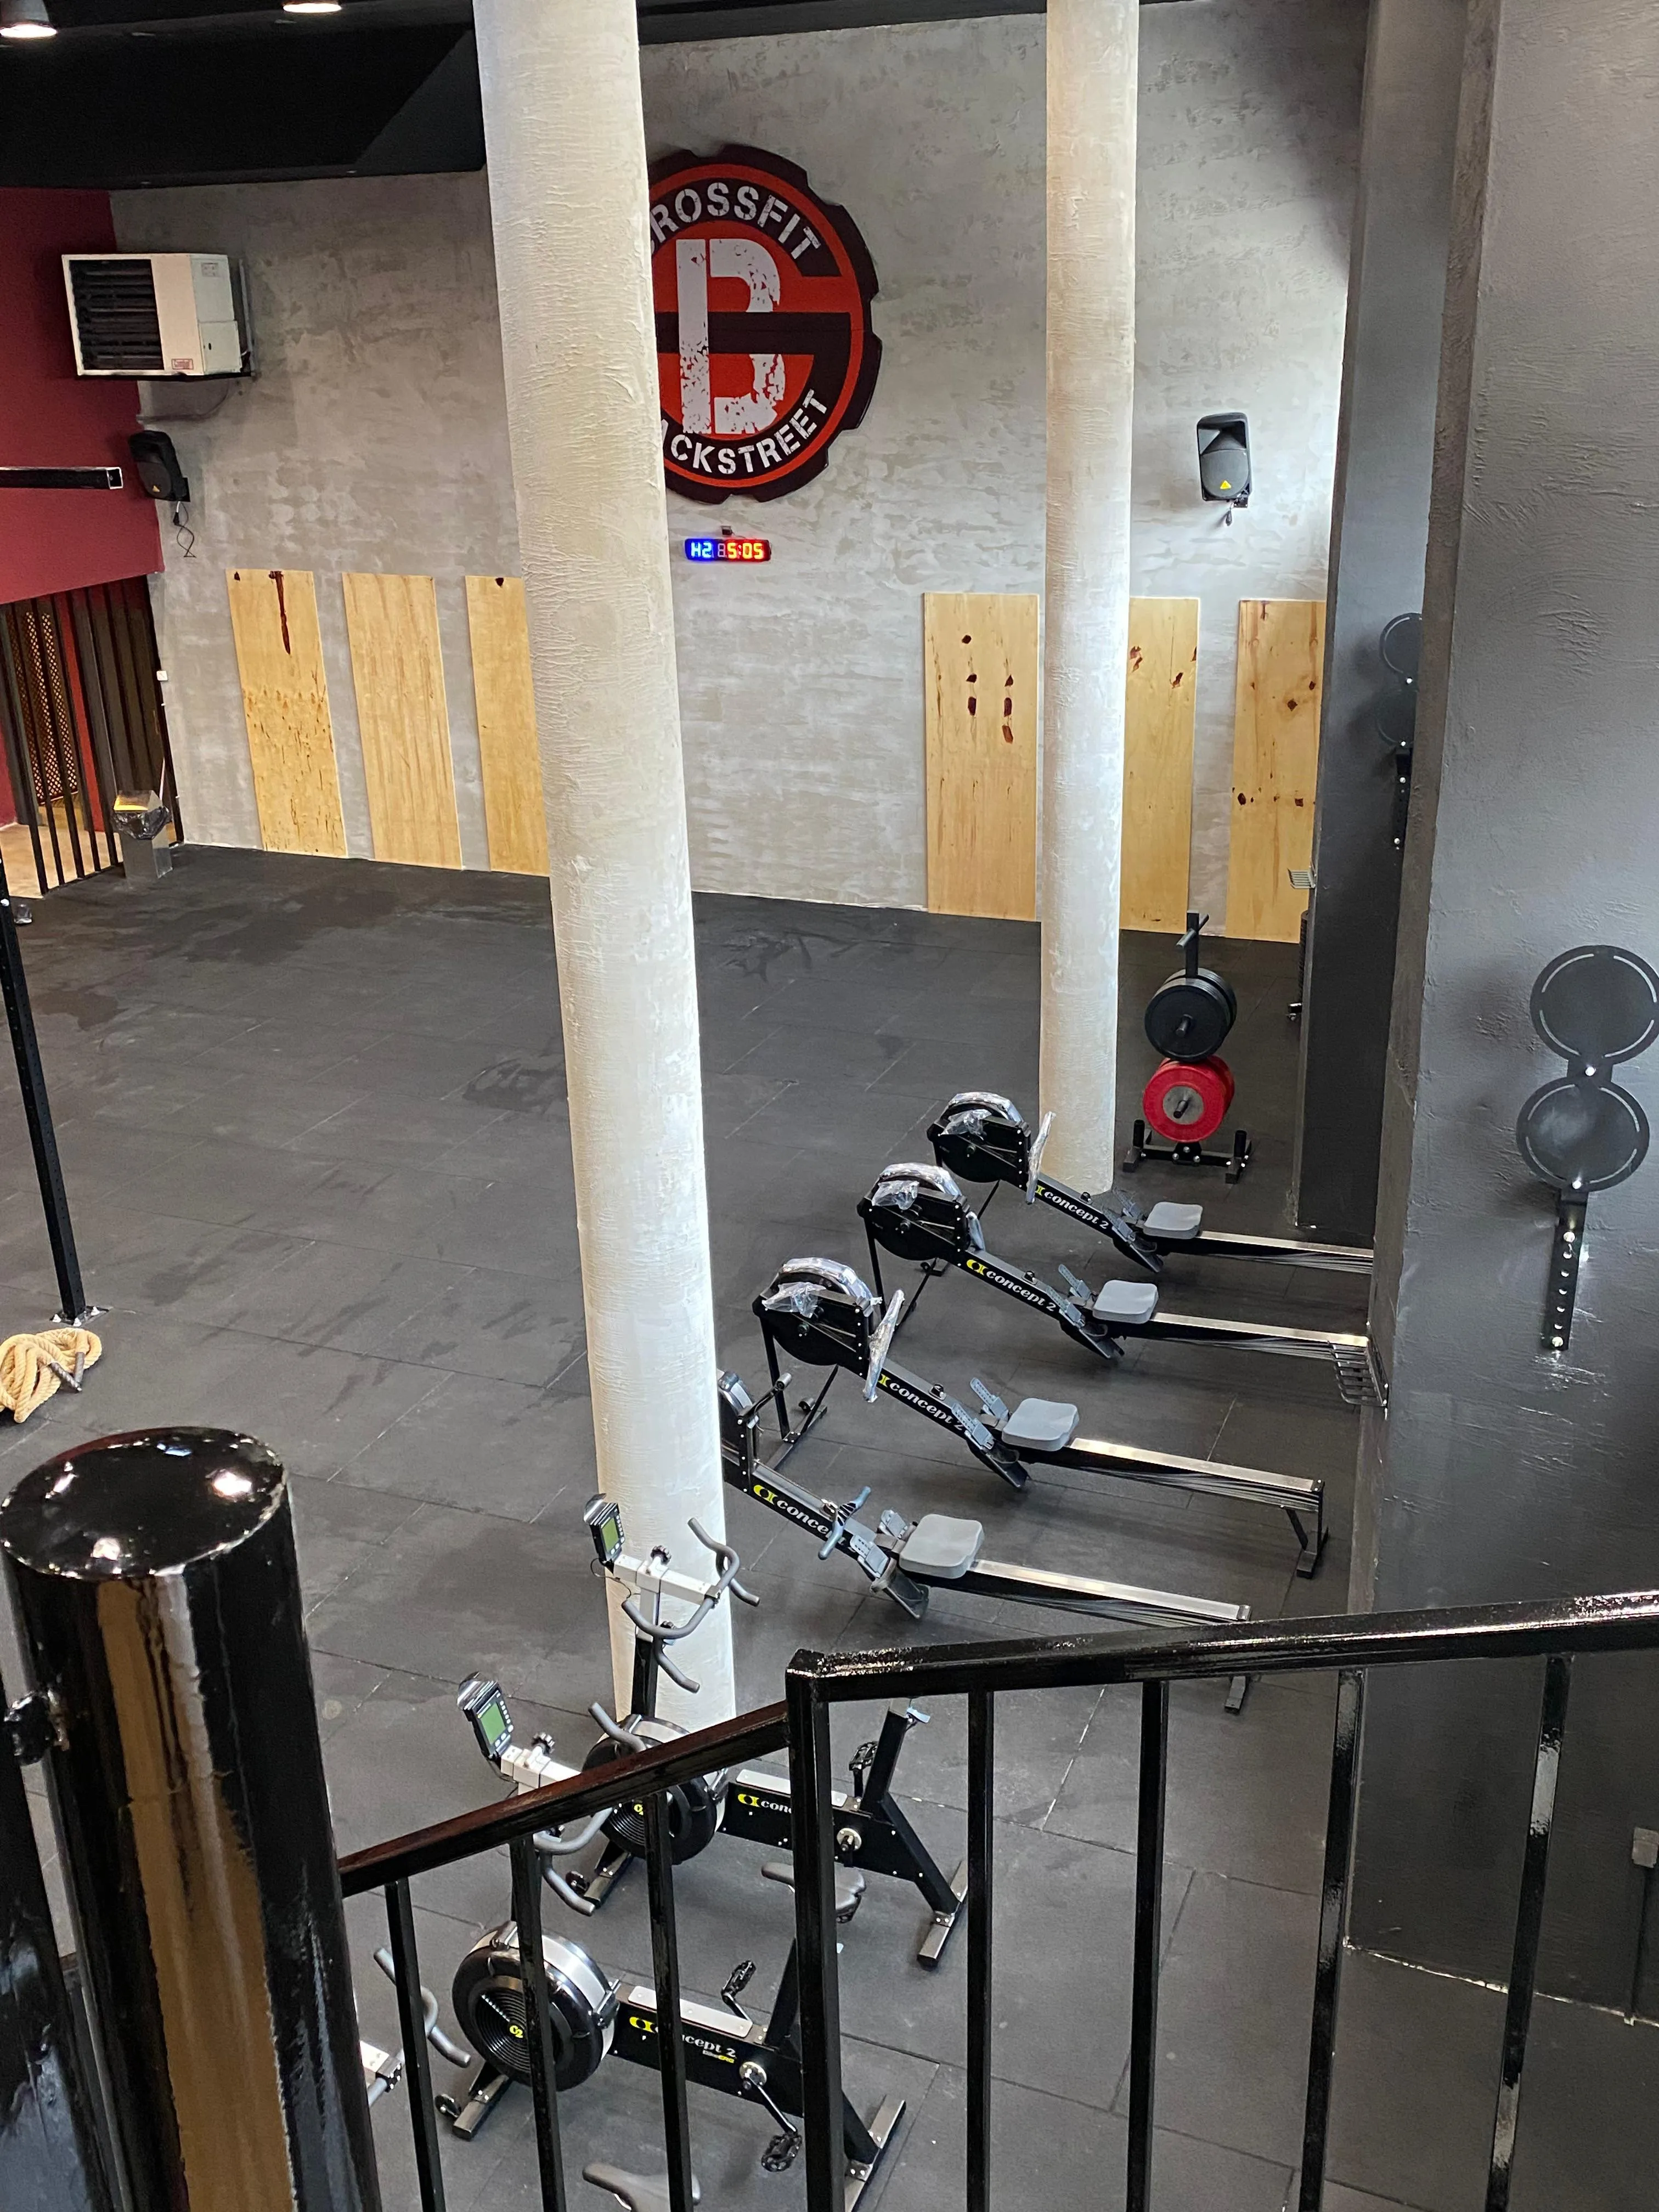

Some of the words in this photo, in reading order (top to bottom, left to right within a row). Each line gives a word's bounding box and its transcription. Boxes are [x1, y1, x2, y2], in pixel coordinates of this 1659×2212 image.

[650, 182, 821, 259] ROSSFIT
[661, 388, 827, 475] CKSTREET
[1044, 1192, 1099, 1224] concept
[1099, 1220, 1109, 1229] 2
[986, 1271, 1046, 1306] concept
[1046, 1302, 1056, 1312] 2
[889, 1383, 953, 1424] concept
[726, 2048, 736, 2057] 2
